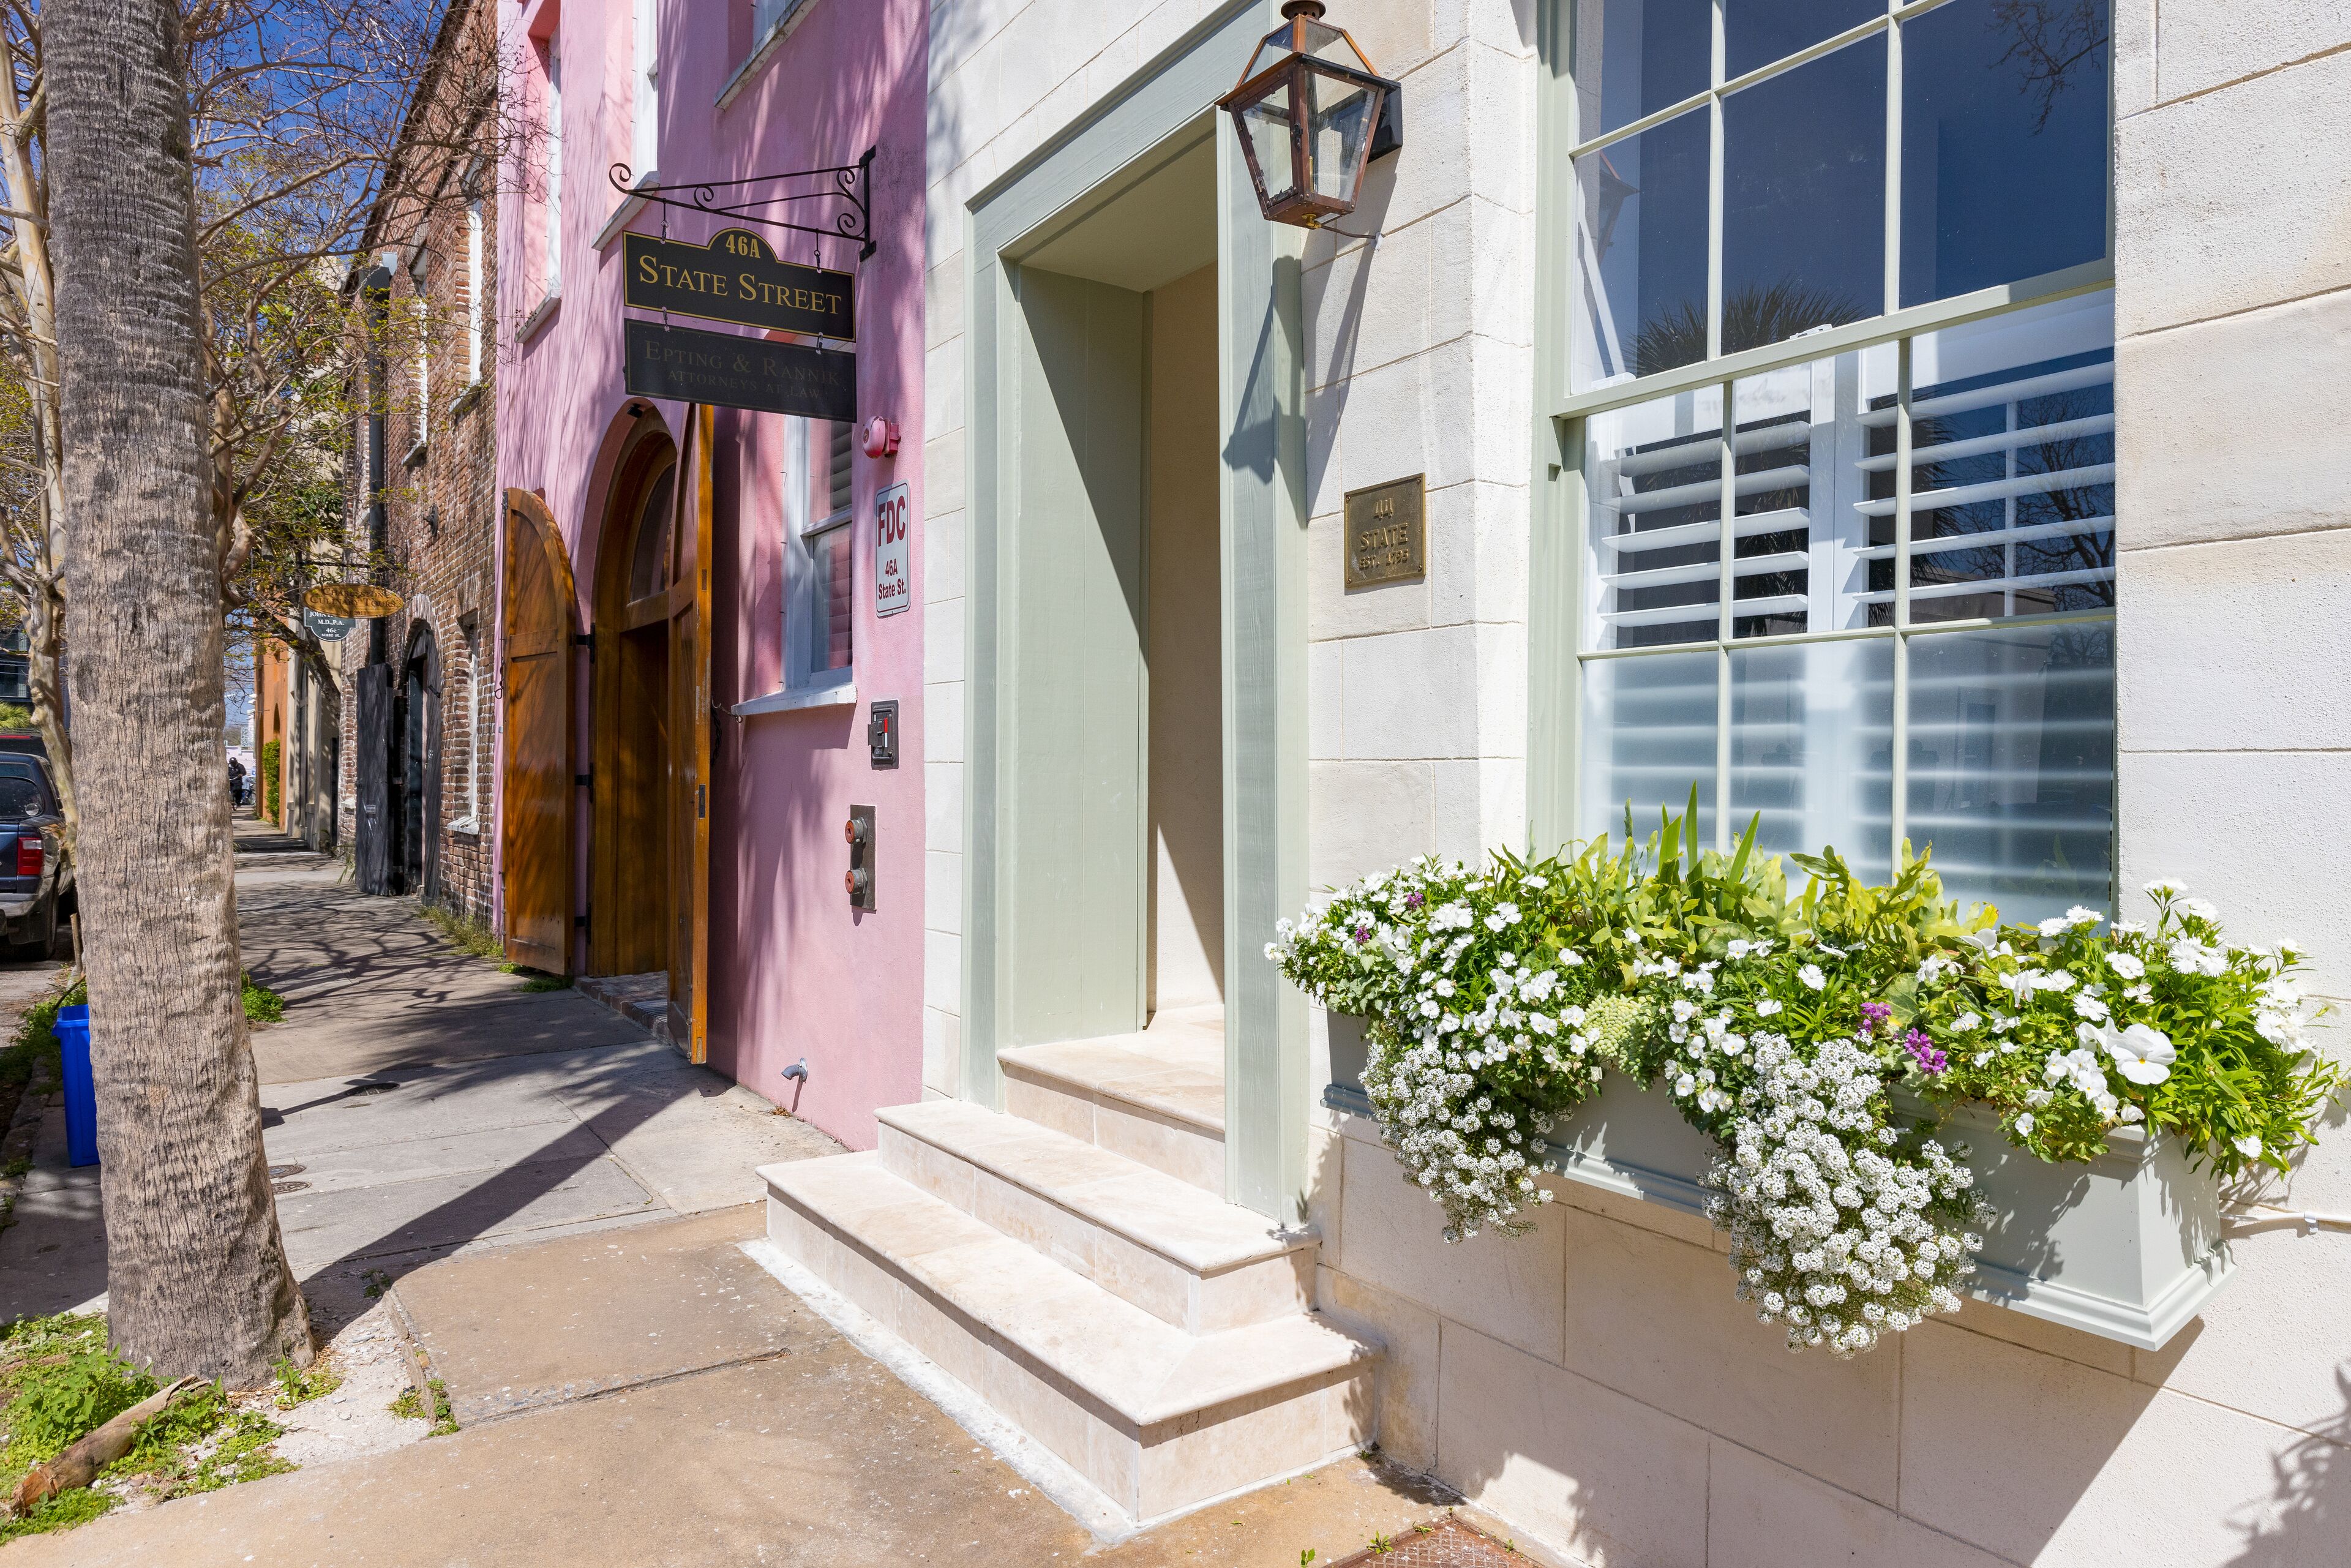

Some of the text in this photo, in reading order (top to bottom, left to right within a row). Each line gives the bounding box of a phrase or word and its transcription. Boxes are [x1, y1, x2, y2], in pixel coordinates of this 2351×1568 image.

[726, 234, 761, 259] 46A
[639, 254, 842, 315] STATE STREET
[645, 340, 839, 386] EPTING & RANNIK
[667, 369, 820, 400] ATTORNEYS AT LAW
[878, 495, 906, 547] FDC
[1373, 498, 1393, 520] 44
[1359, 522, 1409, 552] STATE
[885, 558, 898, 577] 46A
[323, 587, 384, 598] CHARESTON
[878, 577, 906, 600] State St.
[363, 598, 396, 607] TOURS
